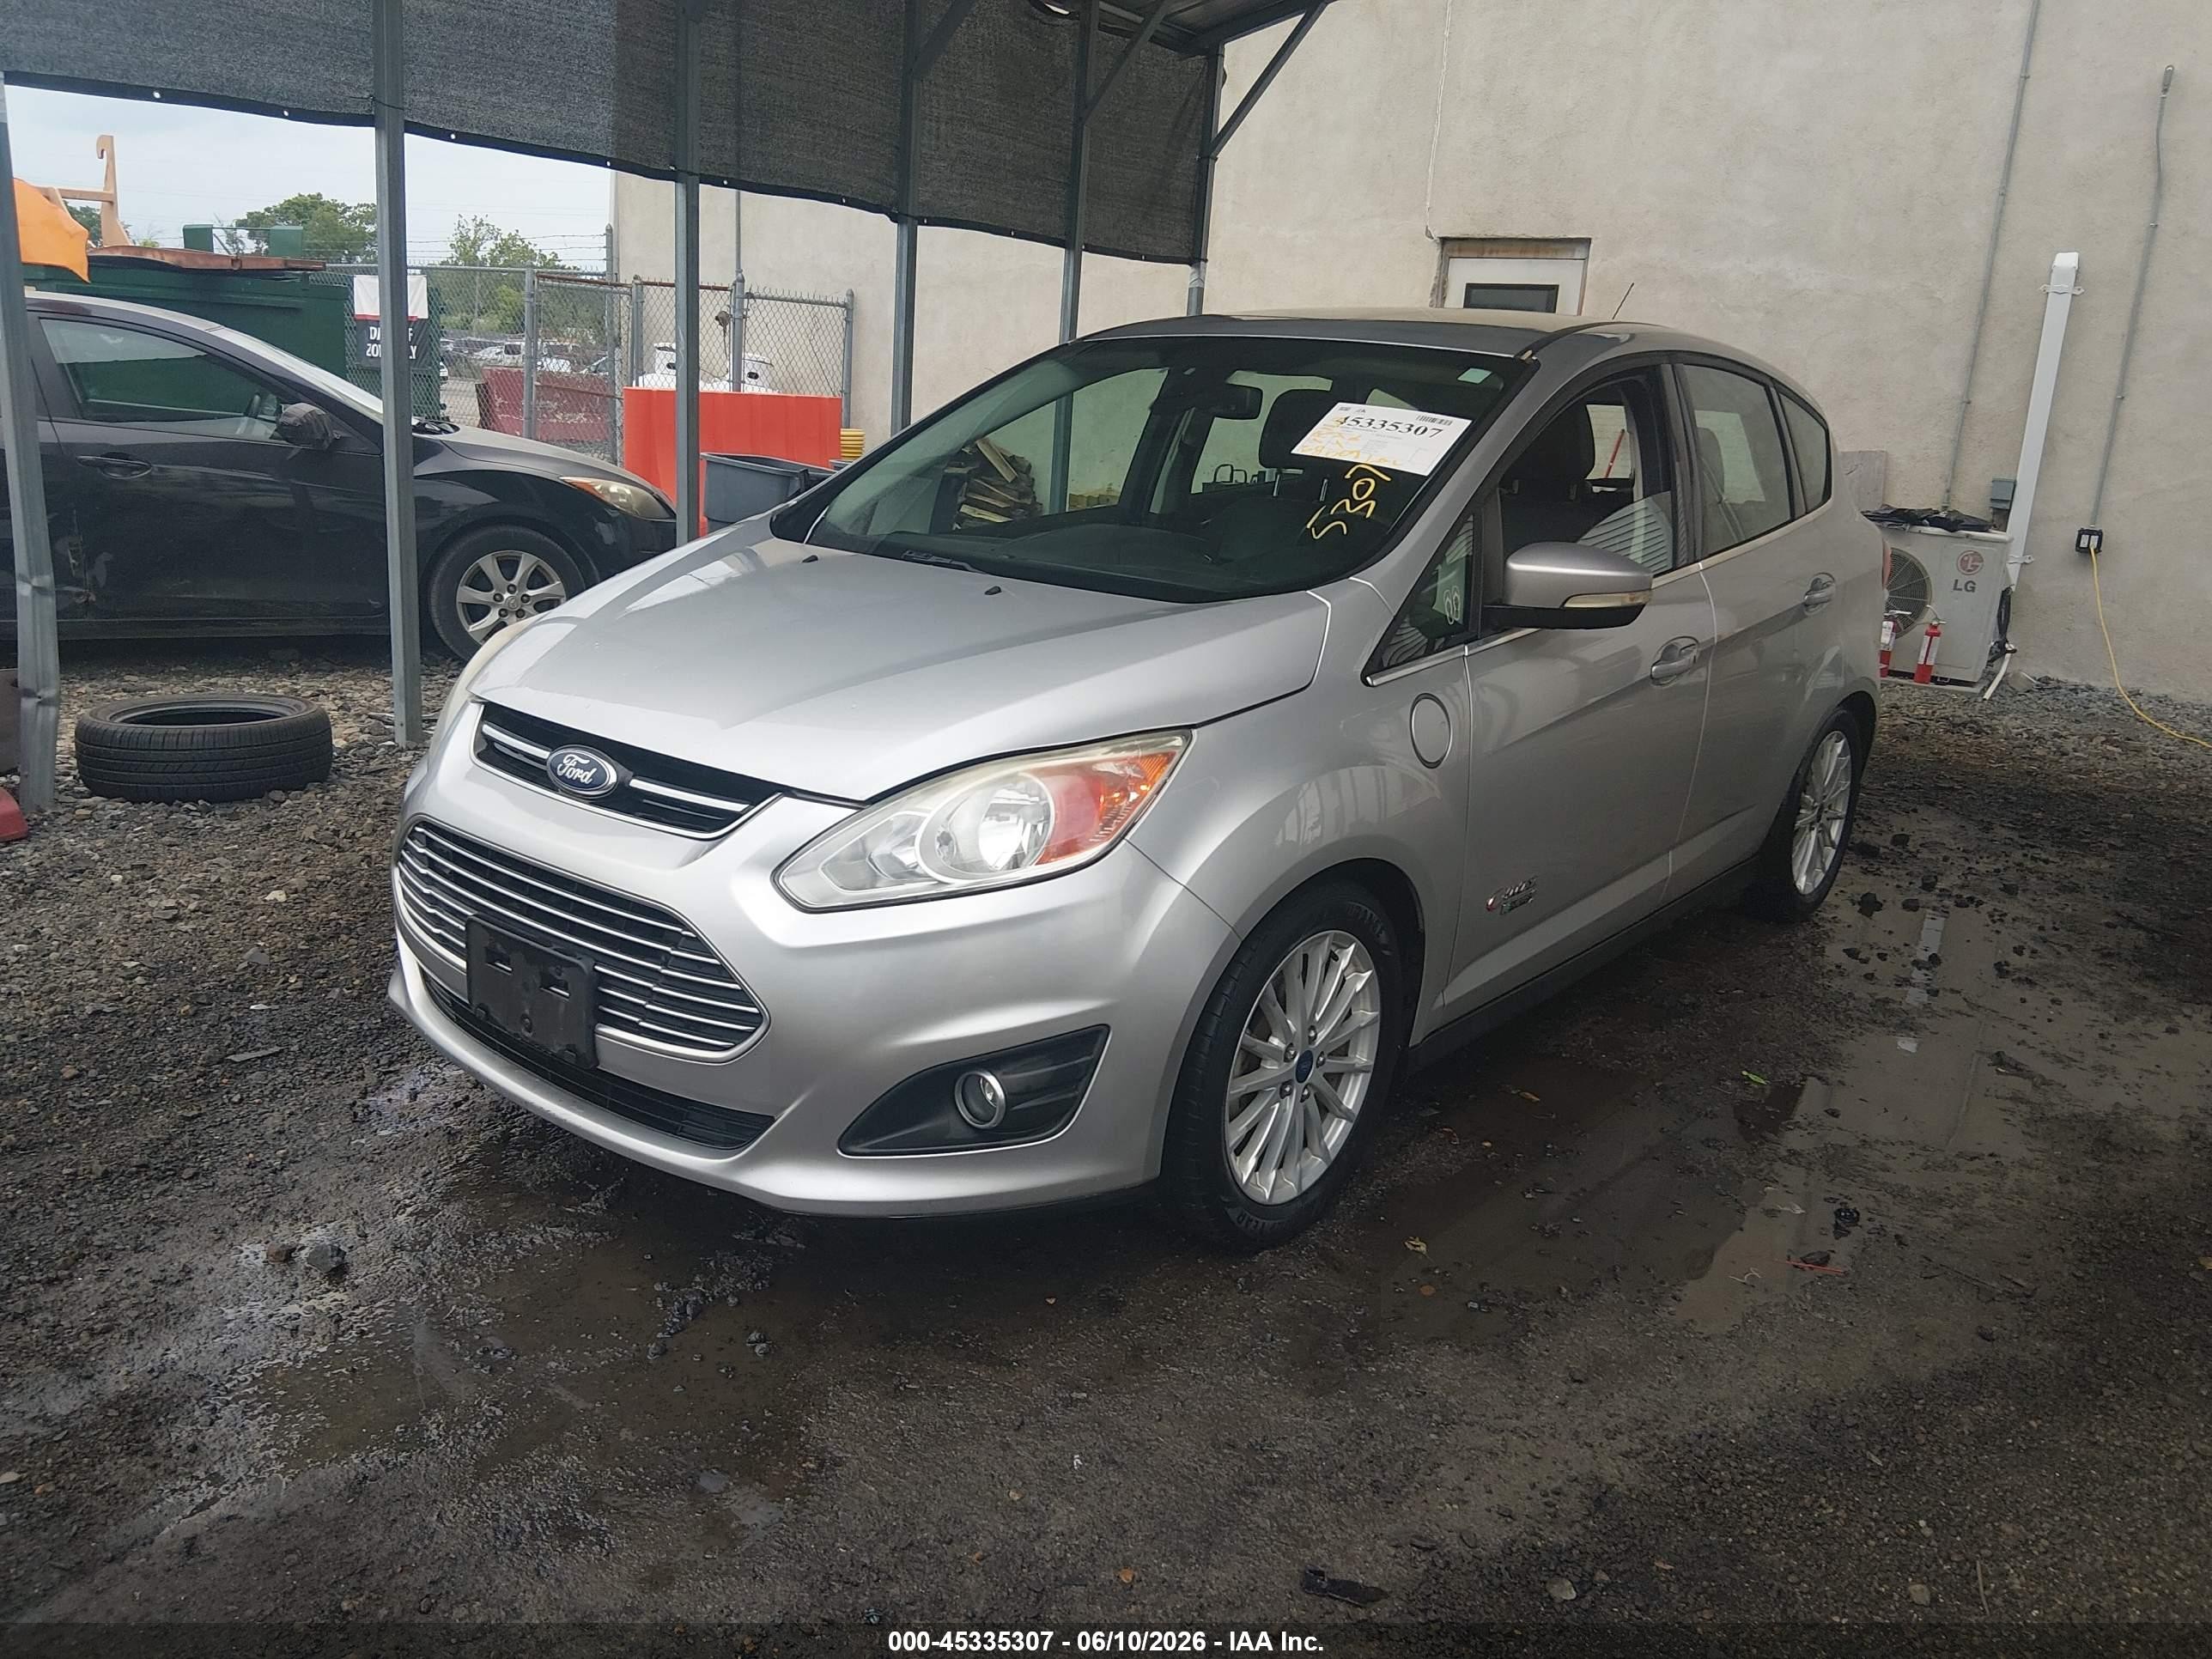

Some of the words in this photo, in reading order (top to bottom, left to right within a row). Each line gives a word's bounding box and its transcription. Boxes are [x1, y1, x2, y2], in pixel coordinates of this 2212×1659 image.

[1335, 416, 1443, 438] 45335307
[1953, 579, 1977, 592] LG
[556, 754, 598, 785] Ford
